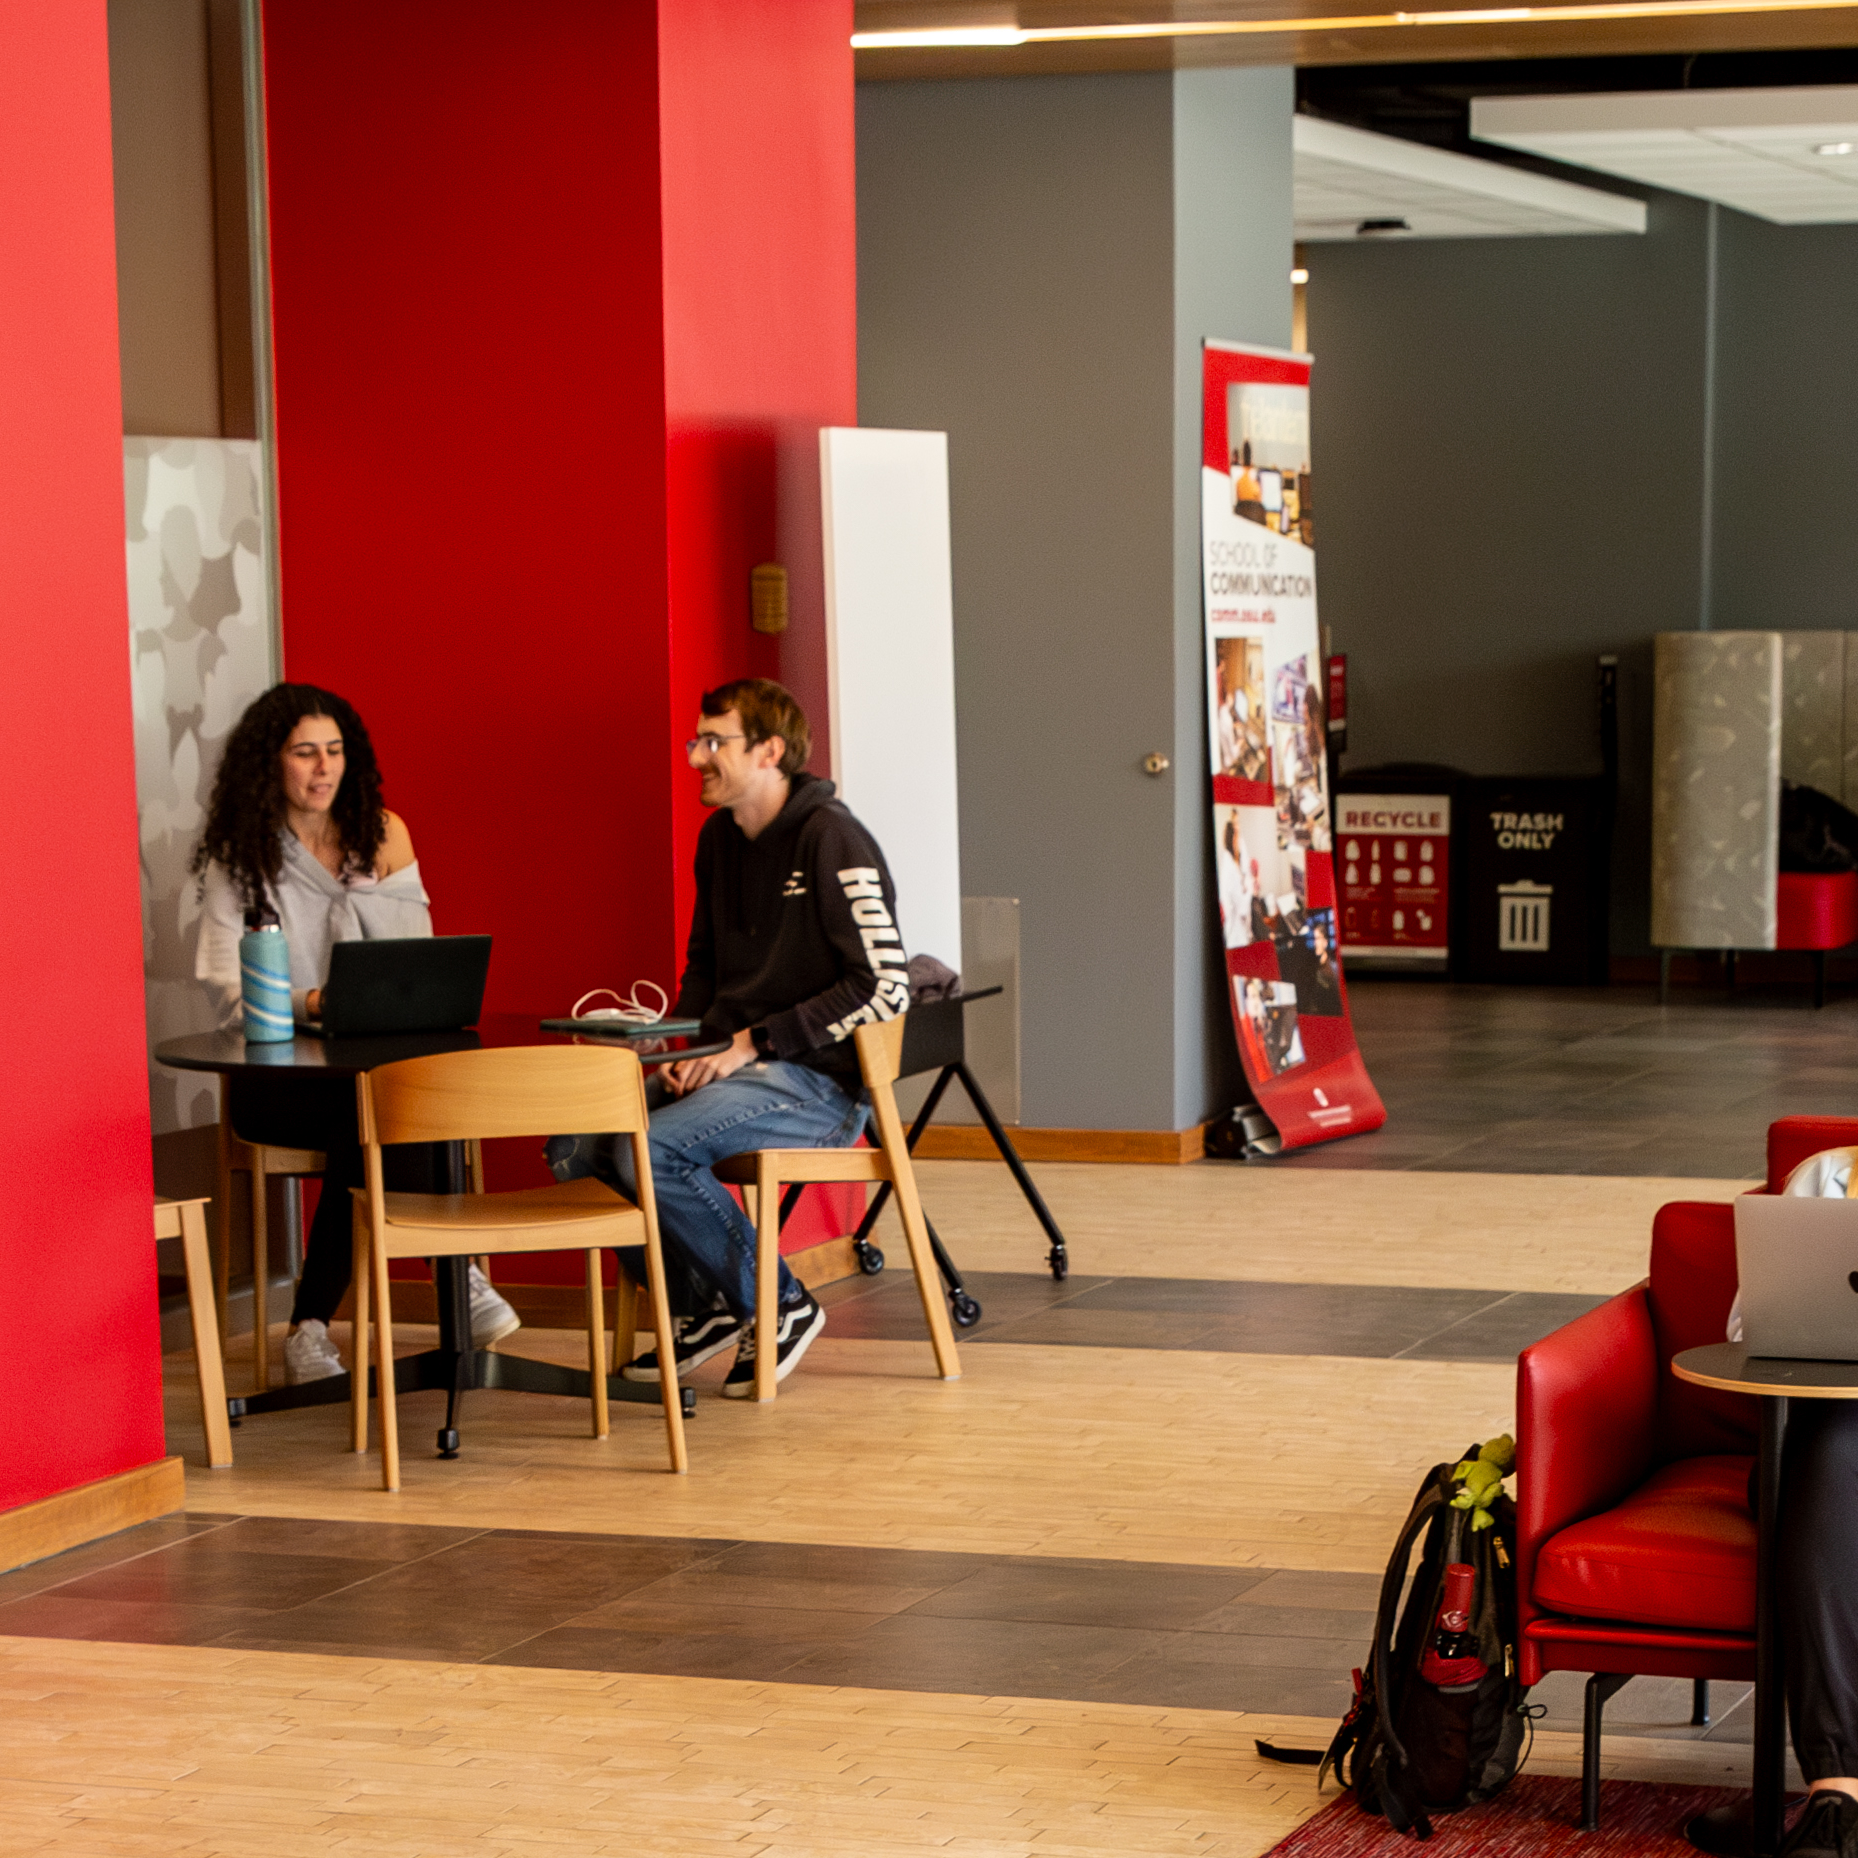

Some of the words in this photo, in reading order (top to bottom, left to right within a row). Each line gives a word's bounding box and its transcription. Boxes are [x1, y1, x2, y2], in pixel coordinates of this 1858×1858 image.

[1209, 540, 1261, 568] SCHOOL
[1263, 542, 1278, 568] OF
[1211, 571, 1312, 598] COMMUNICATION
[1346, 811, 1441, 829] RECYCLE
[1490, 812, 1563, 831] TRASH
[1497, 832, 1556, 850] ONLY
